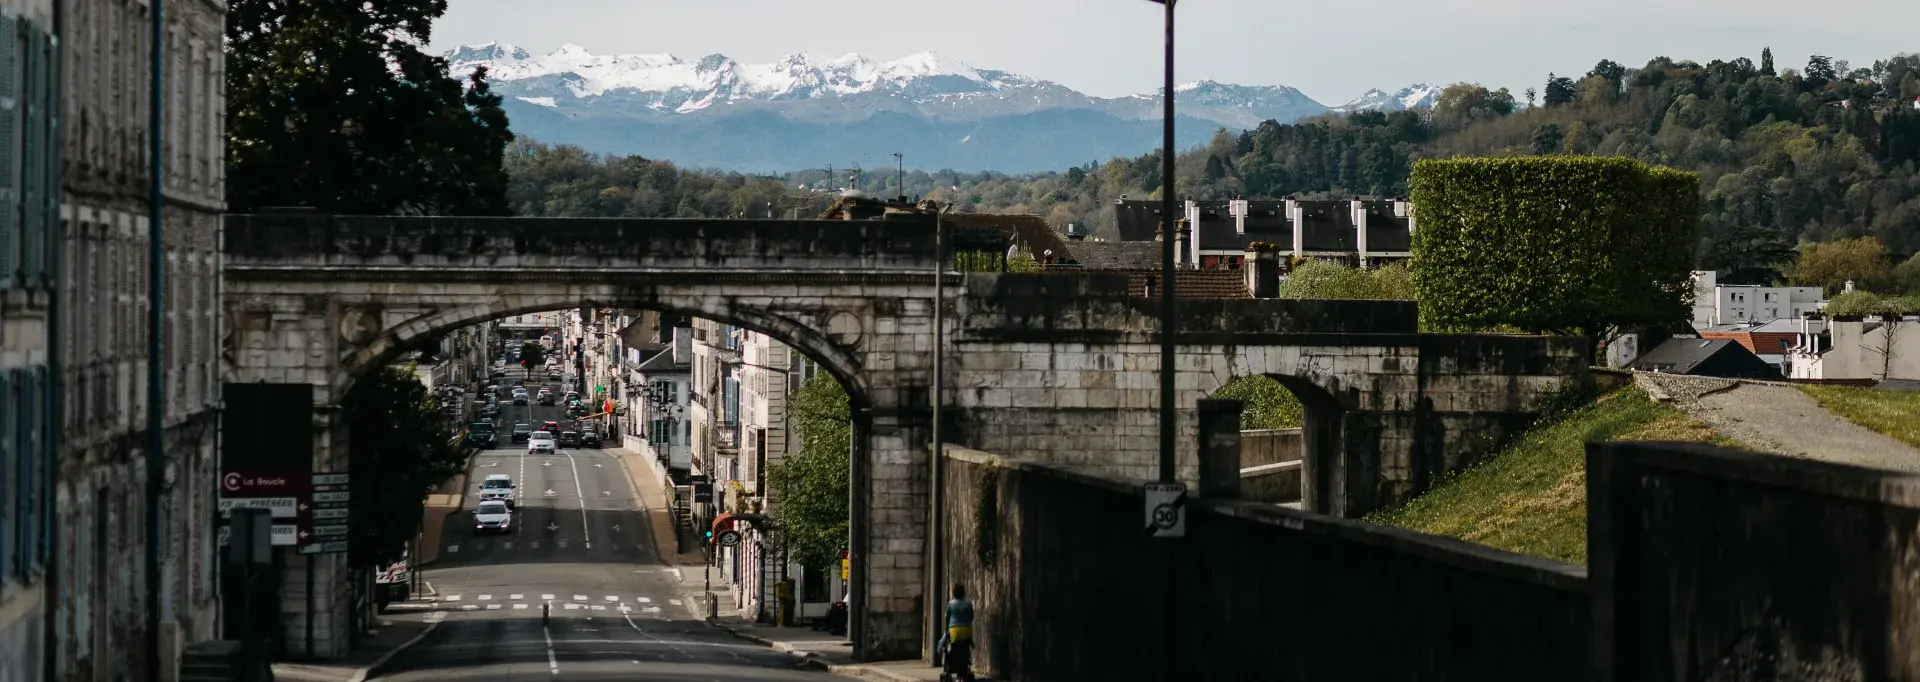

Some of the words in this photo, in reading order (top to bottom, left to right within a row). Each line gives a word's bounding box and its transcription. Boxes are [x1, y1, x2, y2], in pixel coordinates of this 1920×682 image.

[243, 478, 254, 486] La
[257, 477, 286, 486] Boucle
[1158, 510, 1173, 522] 30
